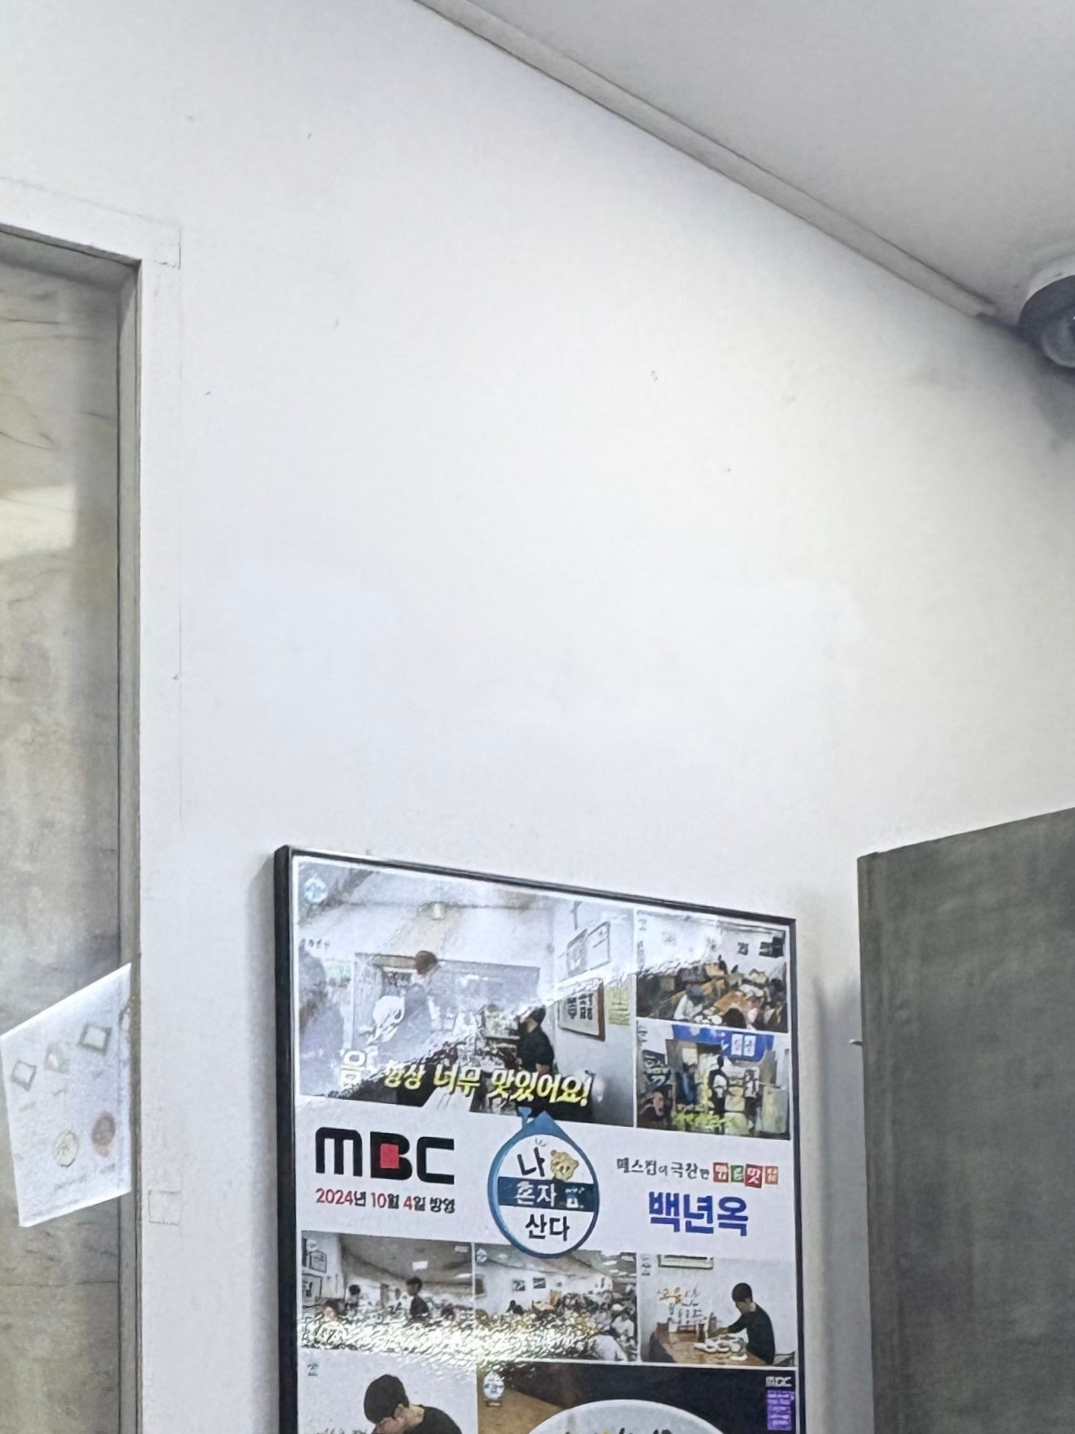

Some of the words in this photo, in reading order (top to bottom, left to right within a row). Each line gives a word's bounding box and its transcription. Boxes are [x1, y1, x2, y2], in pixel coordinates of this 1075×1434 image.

[433, 1063, 481, 1097] 너무
[488, 1067, 593, 1107] 맛있어요!
[315, 1126, 455, 1185] MBC
[517, 1147, 546, 1178] 나
[315, 1187, 366, 1208] 2024년
[371, 1191, 400, 1210] 10월
[403, 1195, 426, 1212] 4일
[430, 1197, 456, 1214] 방영
[514, 1180, 558, 1208] 혼자
[525, 1213, 571, 1242] 산다
[648, 1191, 749, 1237] 백년옥
